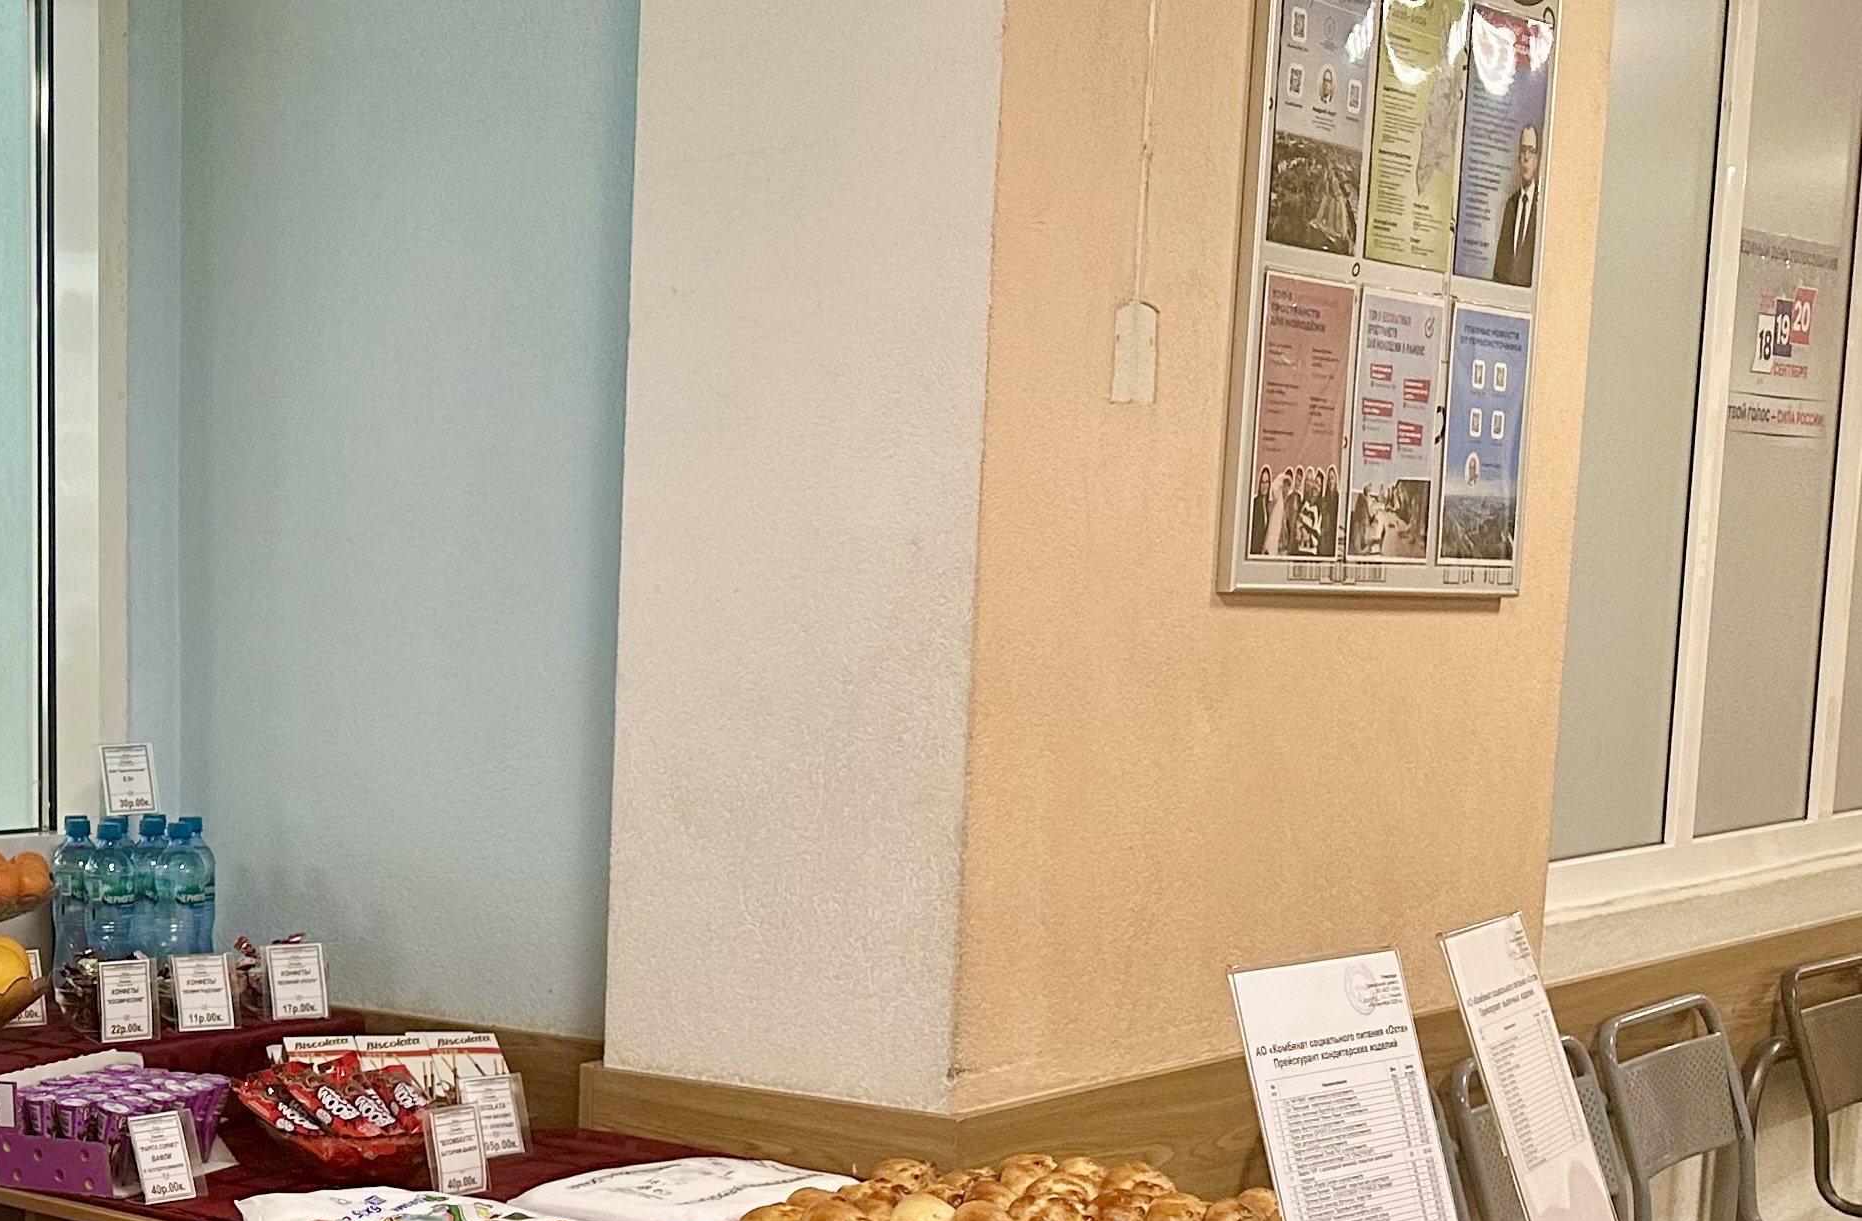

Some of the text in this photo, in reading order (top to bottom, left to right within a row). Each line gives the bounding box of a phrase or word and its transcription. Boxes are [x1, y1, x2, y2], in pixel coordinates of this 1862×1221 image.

[1759, 300, 1811, 361] 18 19 20
[282, 1003, 318, 1015] 17р.00к.
[189, 1012, 224, 1024] 11р.00к.
[111, 1023, 144, 1035] 22р.00к.
[366, 1036, 422, 1051] Biscolata
[437, 1034, 491, 1047] Biscolata
[1255, 1045, 1268, 1057] АО
[151, 1181, 186, 1196] 40р.00к.
[448, 1175, 478, 1190] 40р.00к.
